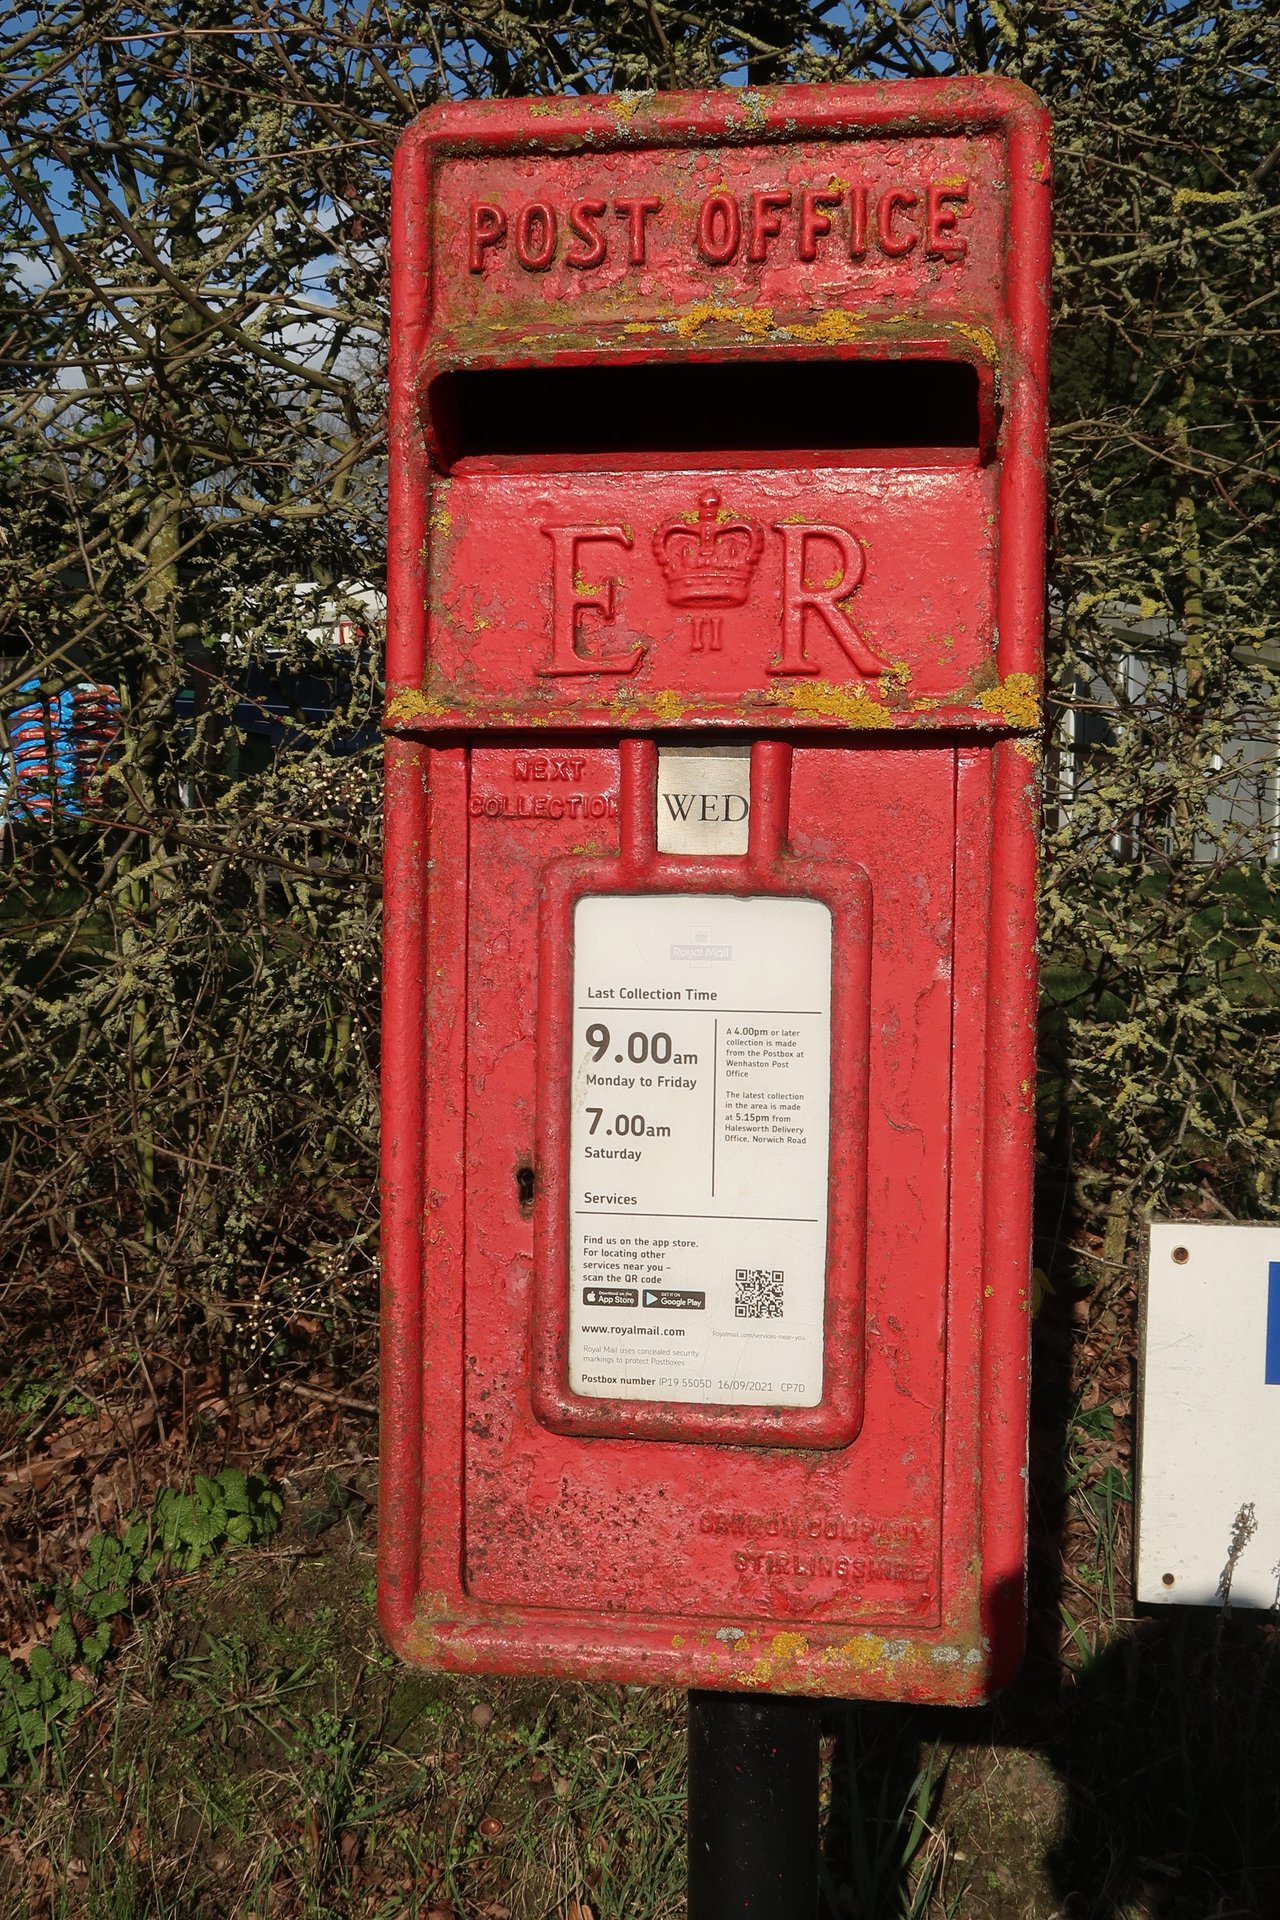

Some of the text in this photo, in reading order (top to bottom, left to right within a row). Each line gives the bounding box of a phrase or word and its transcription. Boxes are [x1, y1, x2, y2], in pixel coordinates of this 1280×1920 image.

[468, 183, 970, 273] POST OFFICE
[536, 520, 892, 678] E R
[690, 616, 724, 651] II
[512, 757, 586, 781] NEXT
[661, 792, 749, 822] WED
[673, 946, 729, 959] Royal Mail
[588, 987, 717, 1001] Last Collection Time
[734, 1028, 768, 1037] 4.00pm
[586, 1024, 698, 1065] 9.00am
[726, 1039, 763, 1047] collection
[763, 1050, 794, 1058] Postbox
[726, 1060, 769, 1068] Wenhaston
[726, 1070, 749, 1078] Office
[586, 1074, 697, 1090] Monday to Friday
[726, 1091, 740, 1099] The
[585, 1108, 671, 1137] 7.00am
[736, 1113, 770, 1124] 5.15pm
[725, 1125, 804, 1134] Halesworth Delivery
[725, 1135, 750, 1143] Office,
[753, 1136, 784, 1144] Norwich
[585, 1147, 642, 1162] Saturday
[584, 1192, 638, 1205] Services
[584, 1235, 603, 1245] Find
[635, 1238, 649, 1246] the
[652, 1240, 670, 1248] app
[673, 1240, 699, 1248] store.
[584, 1248, 666, 1260] For locating other
[583, 1261, 620, 1270] services
[623, 1263, 644, 1271] near
[647, 1264, 664, 1272] you
[607, 1274, 622, 1282] the
[625, 1274, 638, 1283] QR
[641, 1276, 662, 1284] code
[598, 1295, 635, 1304] App Store
[661, 1297, 702, 1308] Google Play
[582, 1325, 685, 1336] www.royalmail.com
[584, 1345, 602, 1354] Royal
[604, 1346, 618, 1354] Mail
[638, 1348, 671, 1356] concealed
[673, 1350, 700, 1358] security
[583, 1356, 614, 1364] markings
[582, 1374, 806, 1393] Postbox number IP19 5505D 16/09/2021 CP7D
